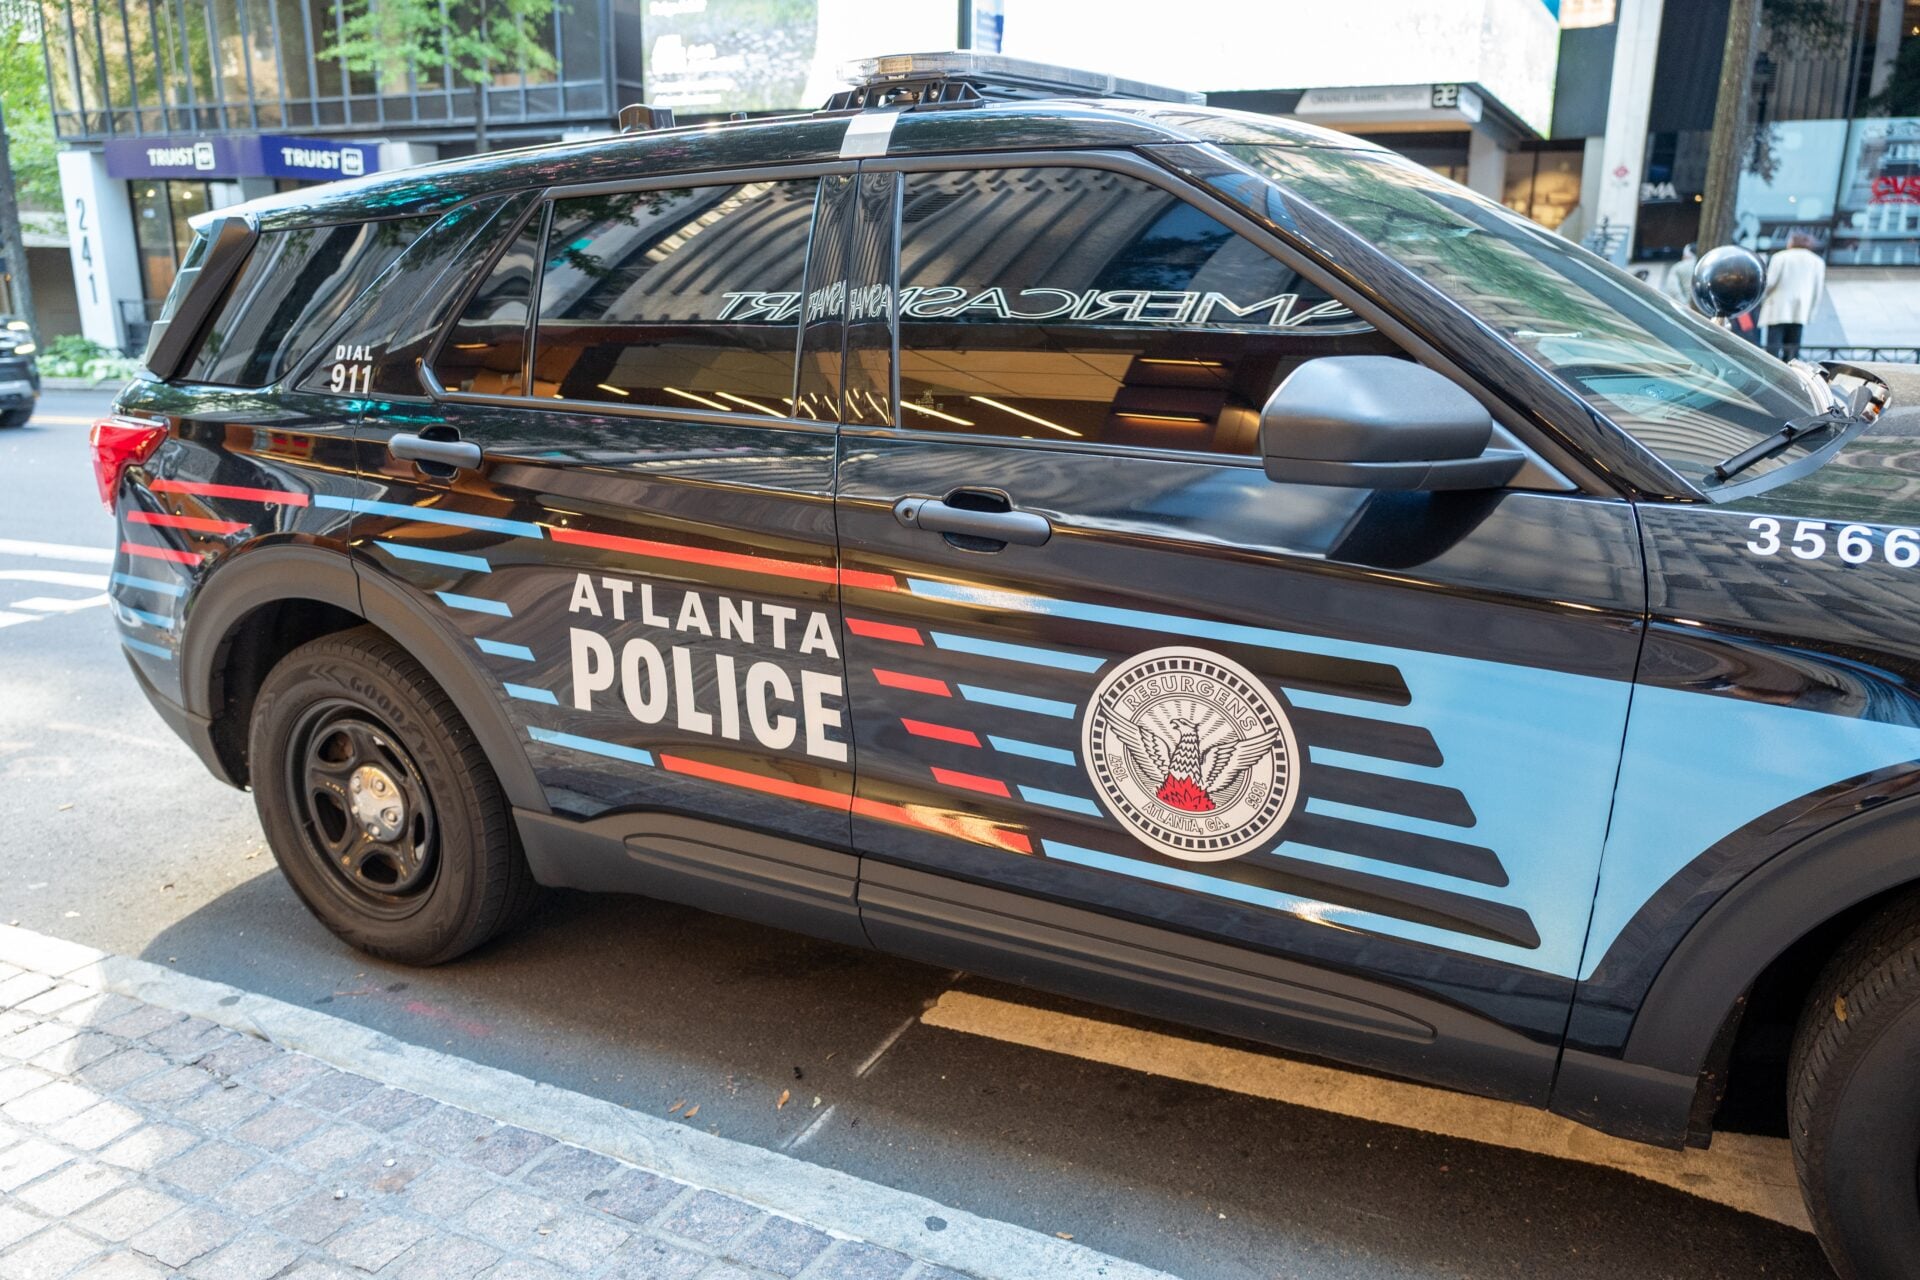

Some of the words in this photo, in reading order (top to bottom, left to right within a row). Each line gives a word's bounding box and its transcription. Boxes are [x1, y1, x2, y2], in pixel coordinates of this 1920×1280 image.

[146, 148, 195, 166] TRUIST
[281, 148, 341, 169] TRUIST
[76, 198, 98, 304] 241
[335, 345, 373, 361] DIAL
[330, 363, 372, 394] 911
[1746, 517, 1920, 568] 3566
[568, 573, 840, 660] ATLANTA
[569, 627, 848, 763] POLICE
[1122, 675, 1258, 732] RESURGENS
[1108, 753, 1129, 782] 1847
[1205, 817, 1230, 832] GA.
